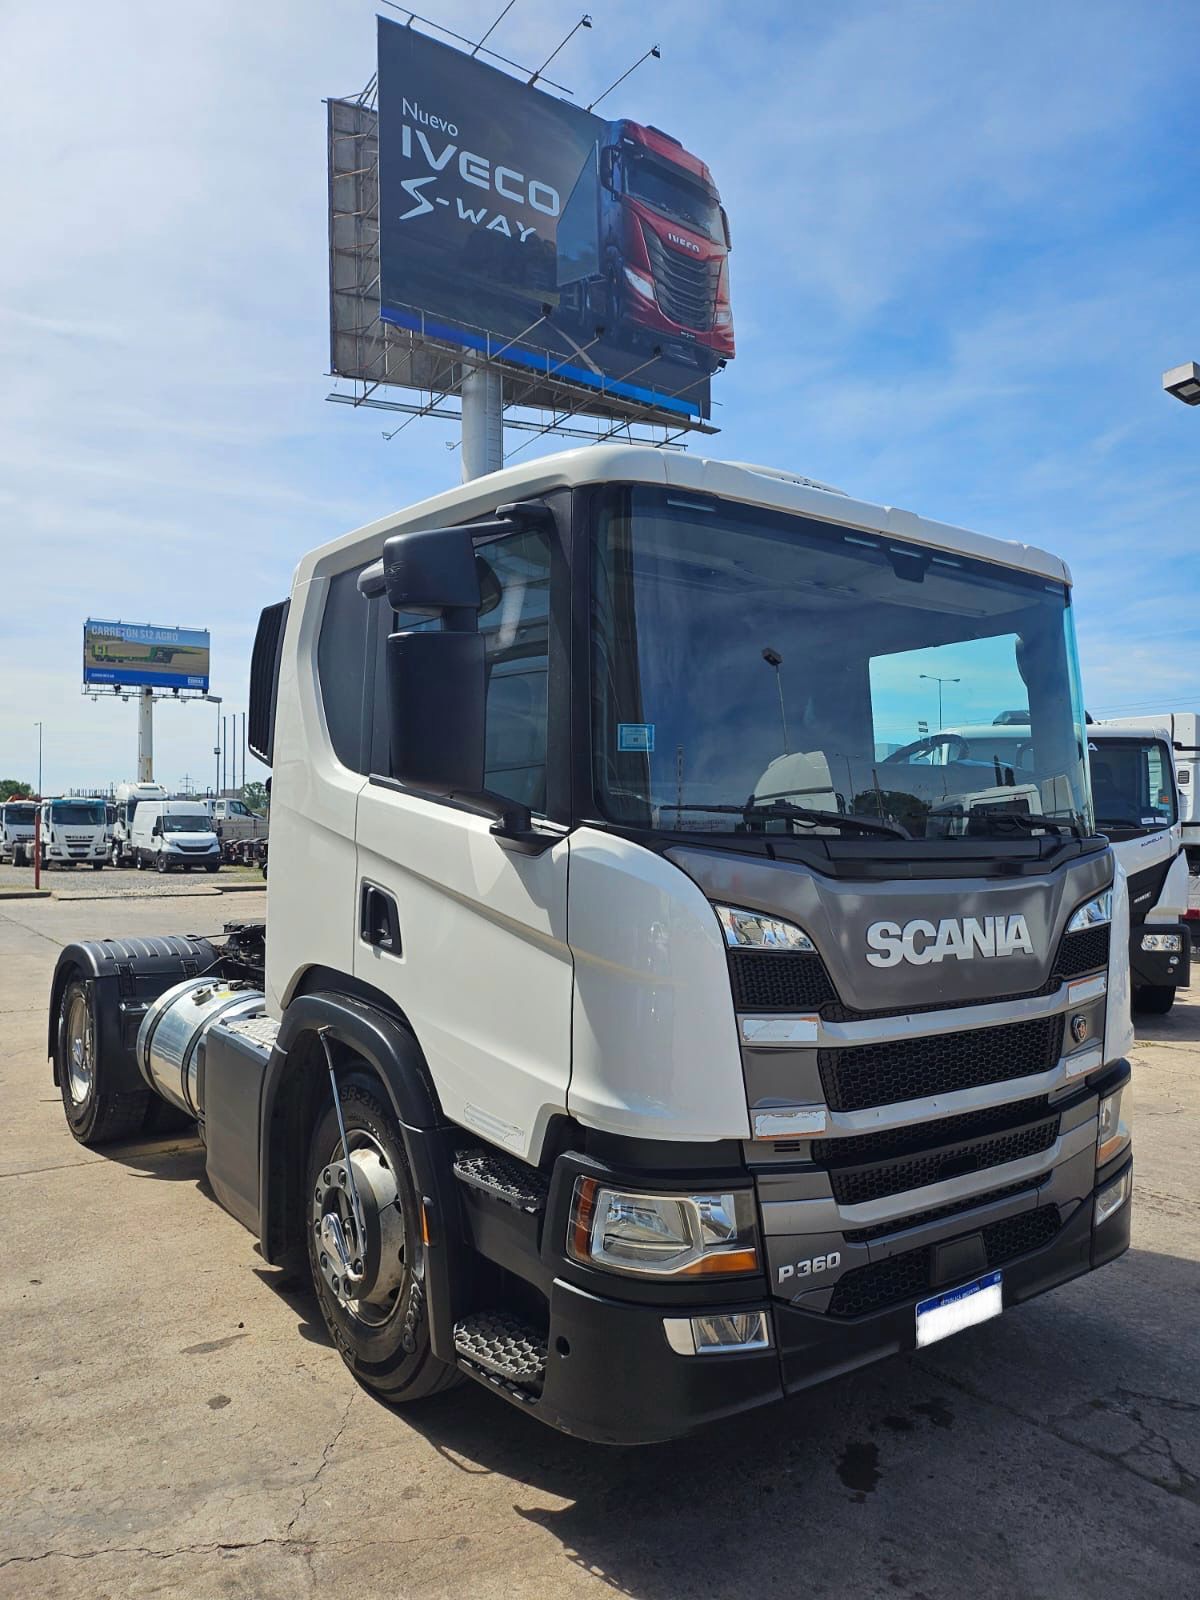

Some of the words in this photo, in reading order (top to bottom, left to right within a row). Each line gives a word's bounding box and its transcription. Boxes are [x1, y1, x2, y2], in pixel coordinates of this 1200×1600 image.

[402, 97, 458, 137] Nuevo
[402, 125, 560, 217] IVECO
[400, 176, 537, 242] S-WAY
[668, 232, 700, 252] IVECO
[866, 914, 1034, 968] SCANIA
